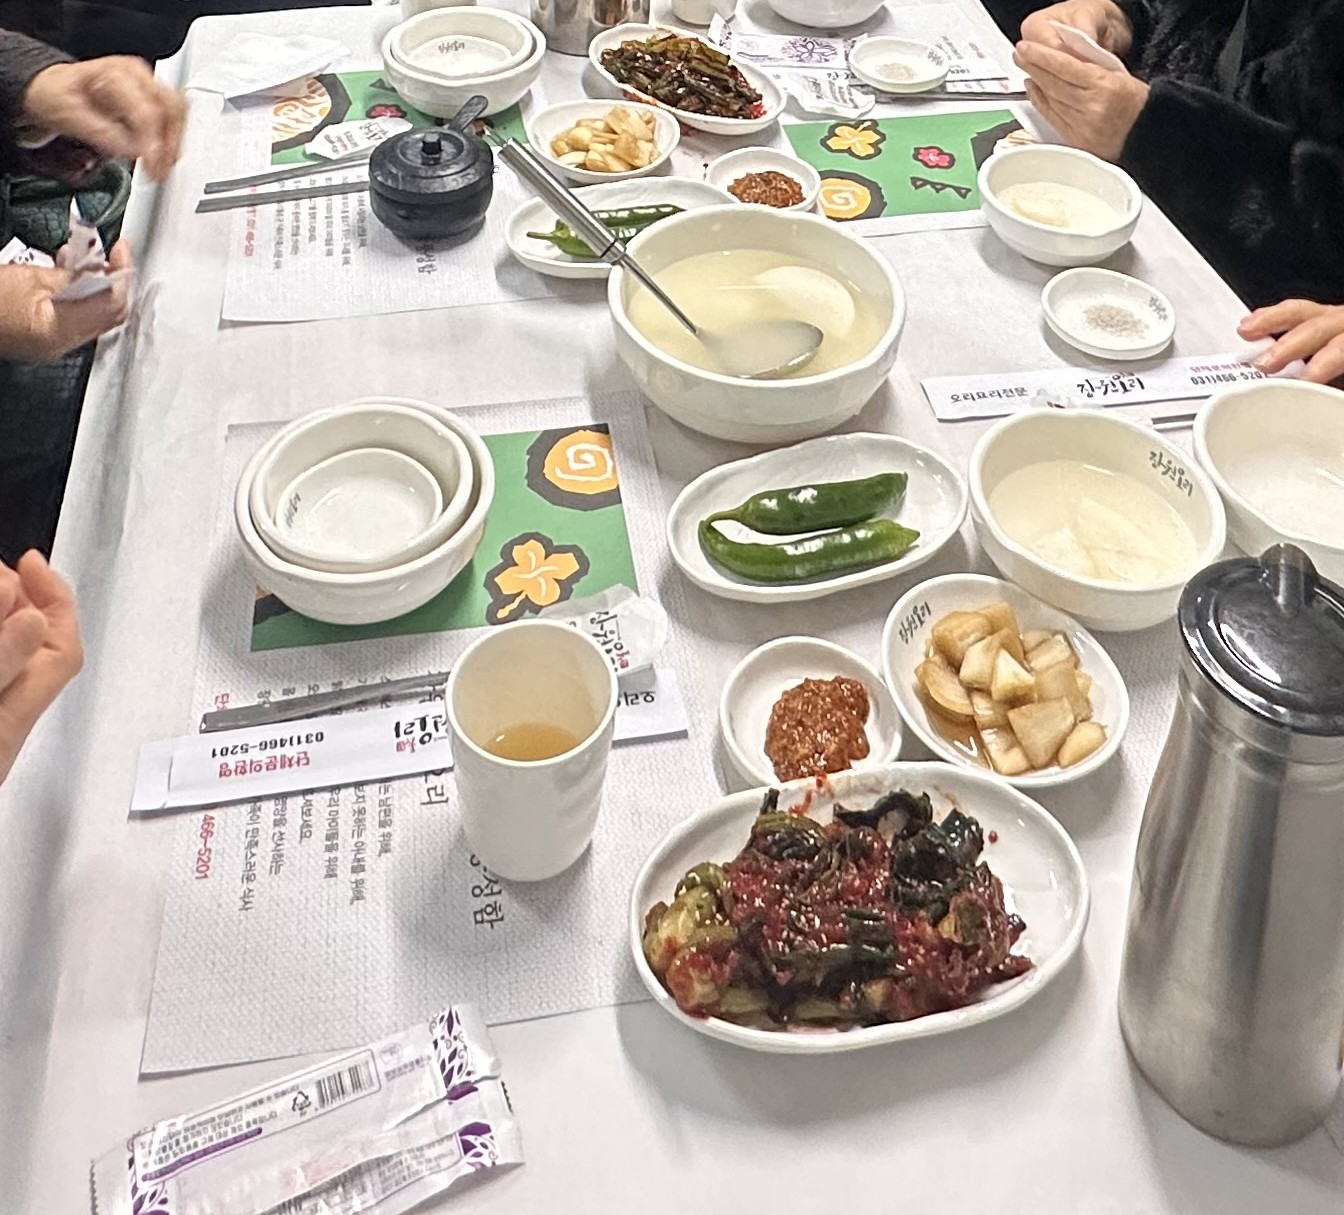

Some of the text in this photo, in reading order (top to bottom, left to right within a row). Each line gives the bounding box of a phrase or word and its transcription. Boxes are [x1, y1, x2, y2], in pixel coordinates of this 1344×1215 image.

[950, 386, 1028, 404] 오리요리전문
[210, 730, 325, 760] 031)466-5201
[217, 749, 311, 780] 단체문의환영
[378, 796, 392, 829] 남편을
[194, 814, 216, 881] 466-5201
[242, 827, 258, 884] 만족스러운
[269, 831, 285, 877] 선사하는
[350, 841, 365, 874] 아내를
[324, 856, 338, 879] 위해
[239, 887, 255, 912] 식사
[469, 854, 505, 930] 성함
